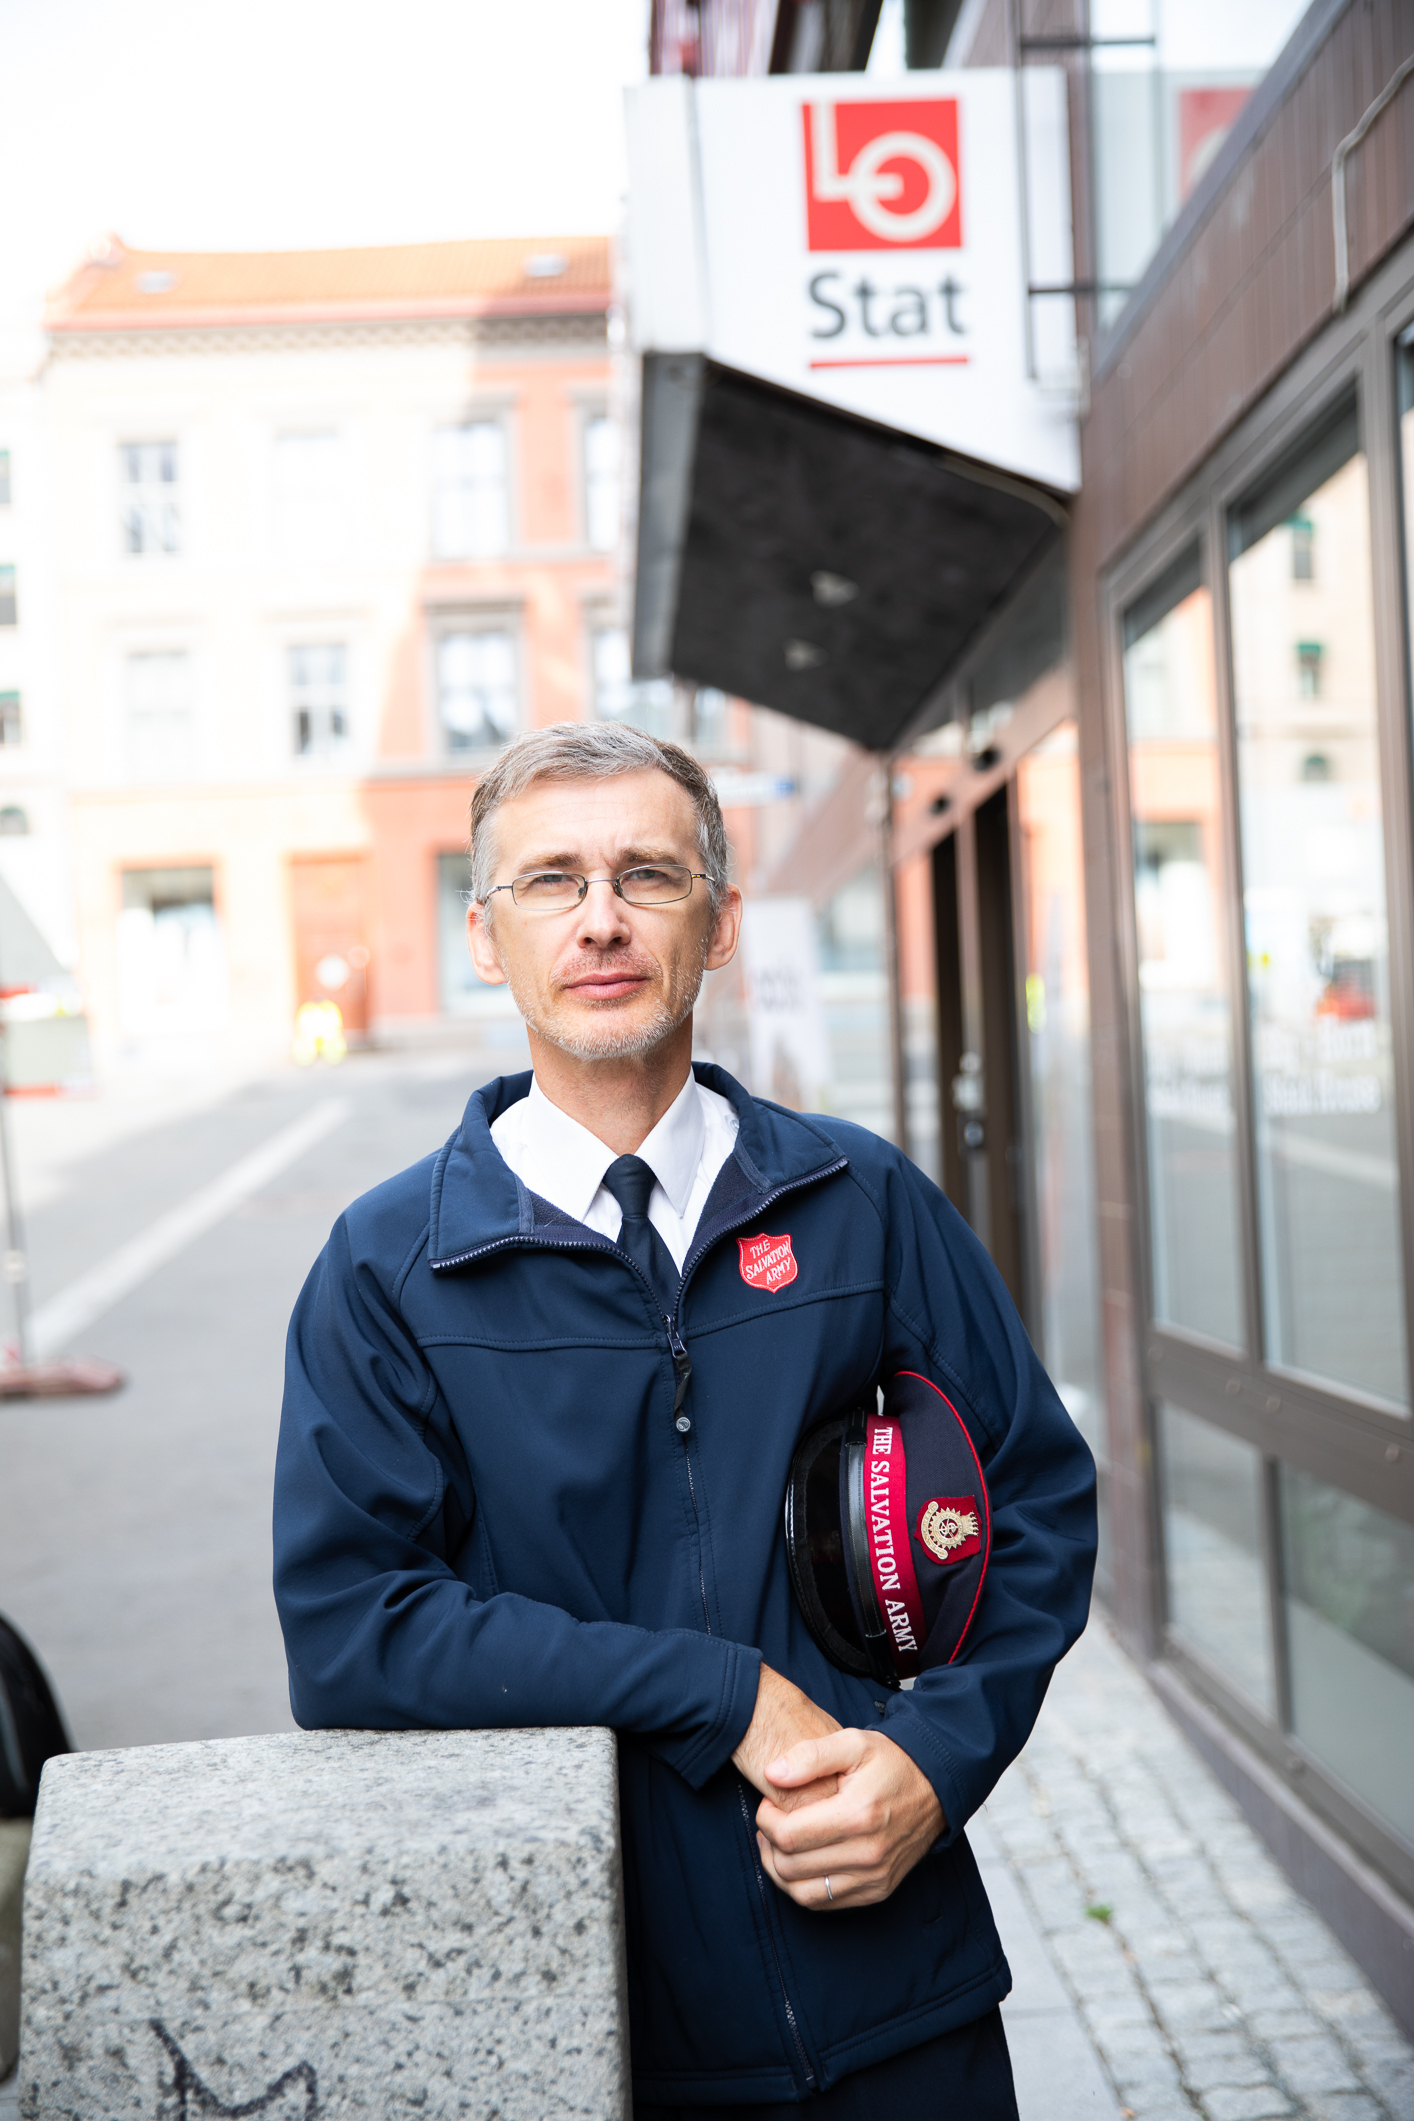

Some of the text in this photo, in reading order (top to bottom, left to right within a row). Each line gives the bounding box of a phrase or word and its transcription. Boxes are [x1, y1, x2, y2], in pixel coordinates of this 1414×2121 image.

[811, 98, 957, 243] LO
[808, 269, 967, 339] Stat
[745, 1241, 790, 1279] SALVATION
[750, 1239, 770, 1259] THE
[766, 1257, 791, 1285] ARMY
[870, 1427, 918, 1652] THE SALVATION ARMY
